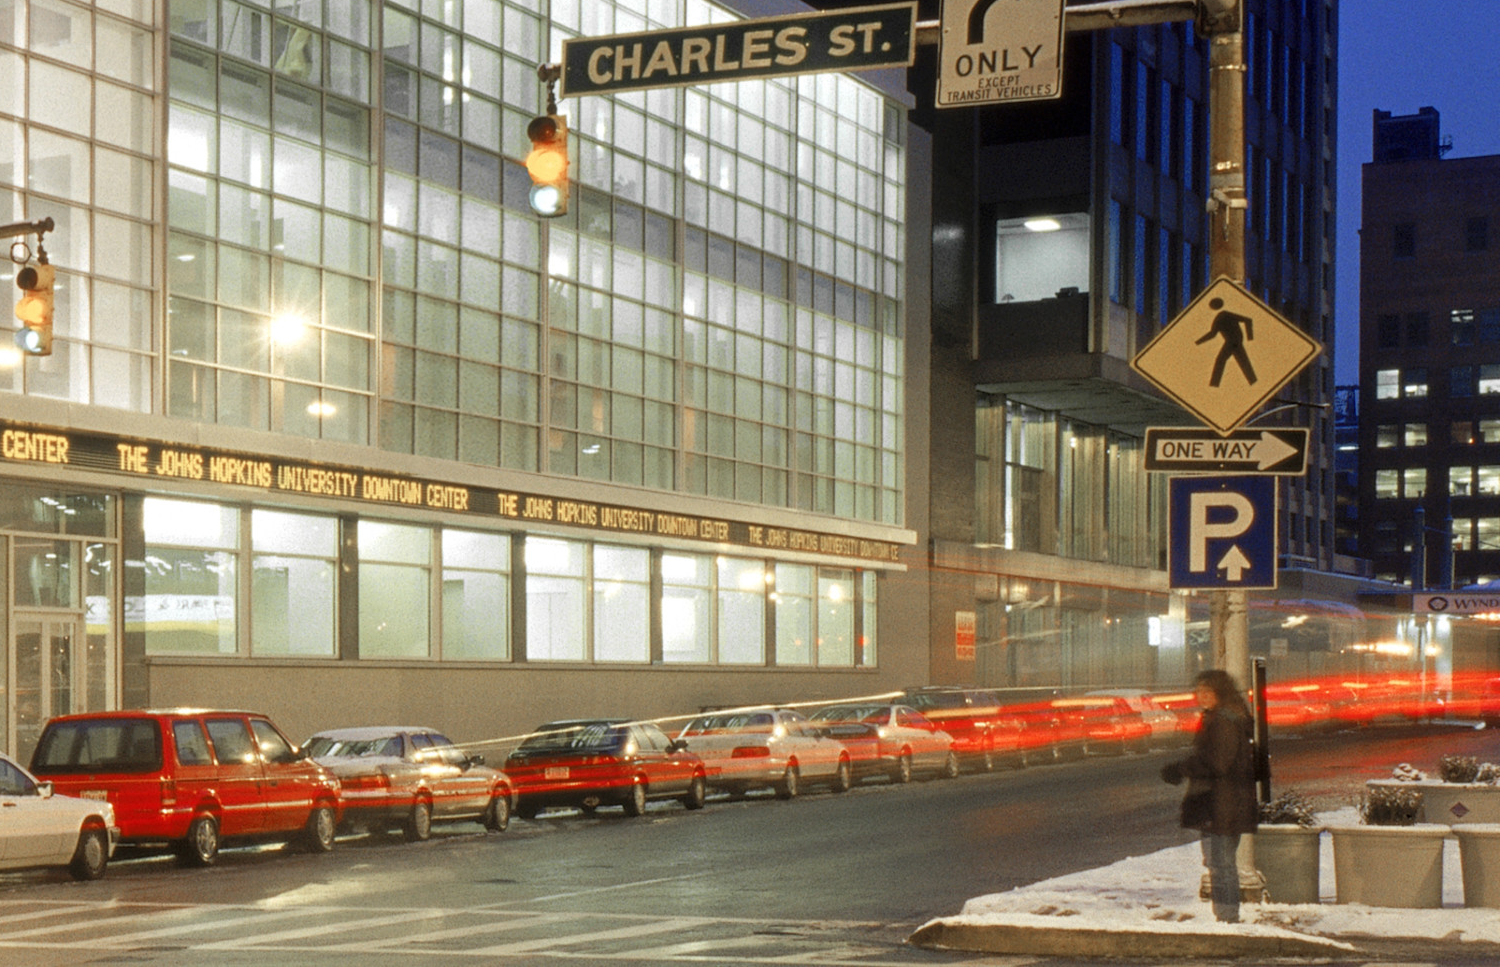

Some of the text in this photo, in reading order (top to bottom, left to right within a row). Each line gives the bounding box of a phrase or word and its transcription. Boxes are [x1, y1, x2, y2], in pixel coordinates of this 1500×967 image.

[587, 22, 891, 84] CHARLES ST.
[955, 44, 1043, 77] ONLY
[947, 84, 1052, 102] TRANSIT VEHICLES
[978, 75, 1020, 89] EXCEPT
[2, 429, 69, 464] CENTER
[1162, 441, 1258, 459] ONE WAY
[117, 444, 468, 510] THE JOHNS HOPKINS UNIVERSITY DOWNTOWN CENTER
[498, 494, 729, 540] THE JOHNS HOPKINS UNIVERSITY DOWNTOWN CENTER
[1190, 492, 1254, 573] P
[748, 526, 763, 545] THE
[765, 529, 787, 547] JOHNS
[790, 532, 818, 551] HOPKINS
[820, 536, 859, 556] UNIVERSITY
[1454, 599, 1499, 609] WYND
